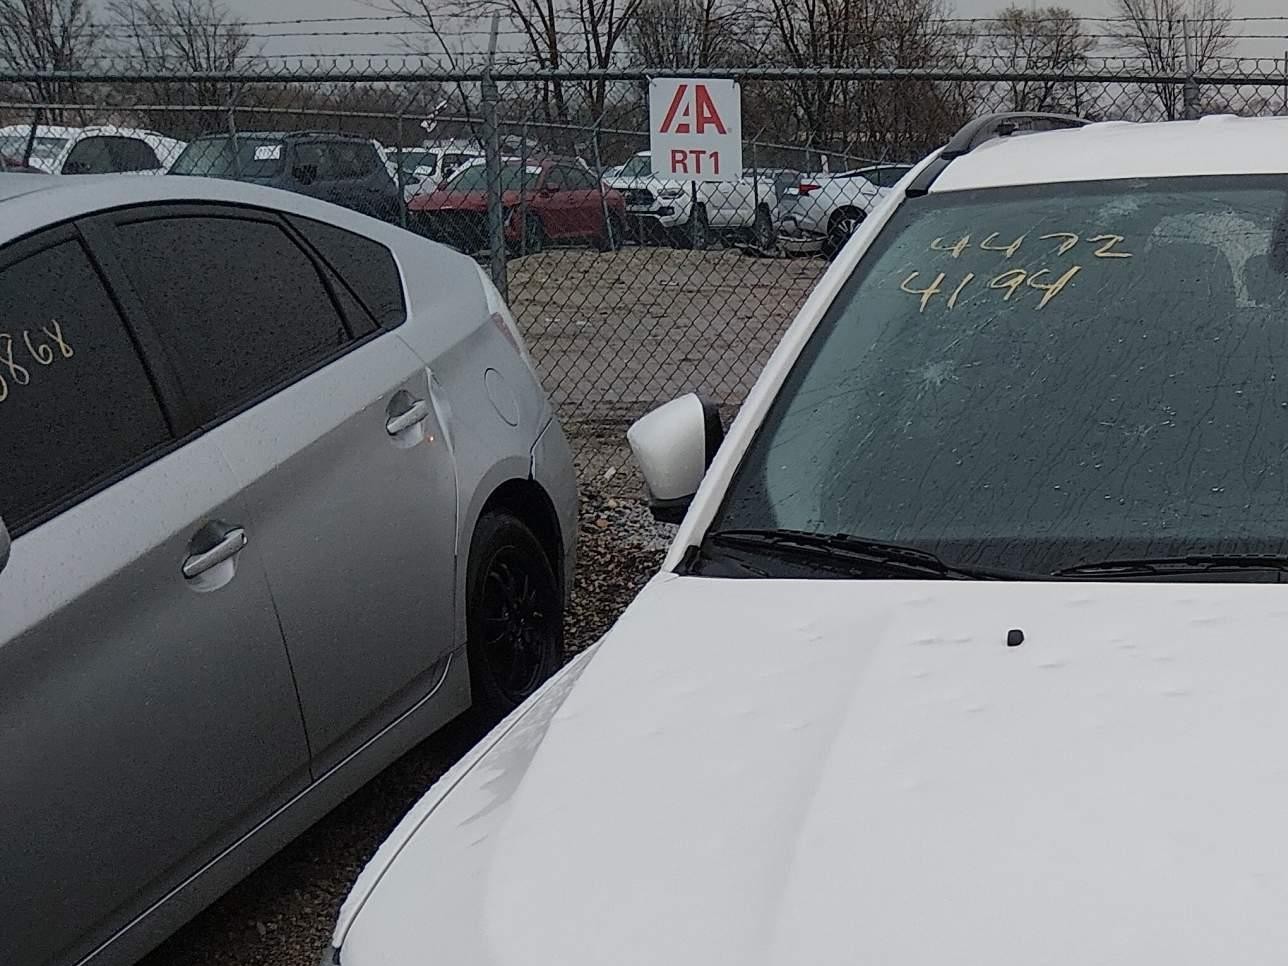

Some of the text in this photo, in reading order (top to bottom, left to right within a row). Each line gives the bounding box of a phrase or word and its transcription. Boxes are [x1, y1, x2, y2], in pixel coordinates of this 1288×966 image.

[671, 150, 719, 174] RT1
[930, 232, 1133, 258] 4472
[900, 266, 1082, 312] 4194
